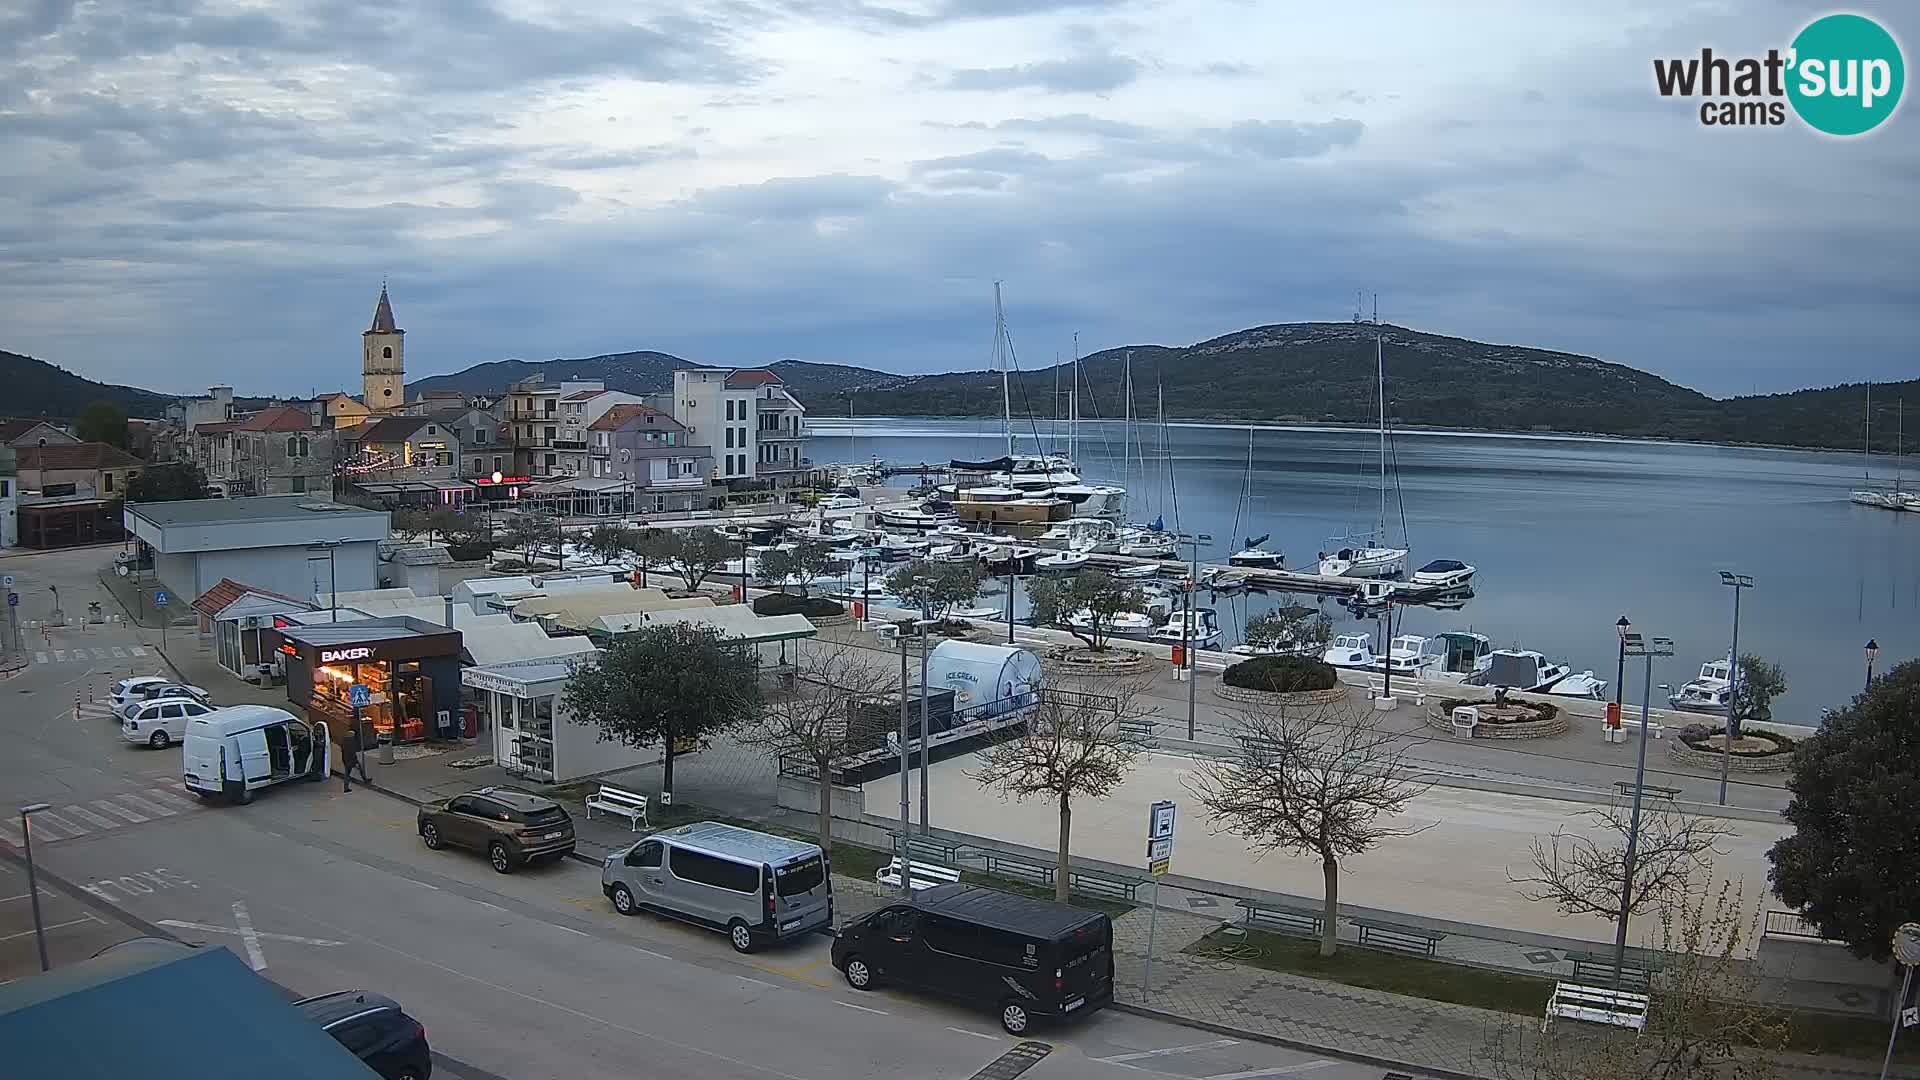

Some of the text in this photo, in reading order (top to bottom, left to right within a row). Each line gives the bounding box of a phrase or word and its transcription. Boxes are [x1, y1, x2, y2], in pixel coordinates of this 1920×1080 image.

[321, 647, 376, 662] BAKERY
[945, 671, 979, 684] ICE CREAM
